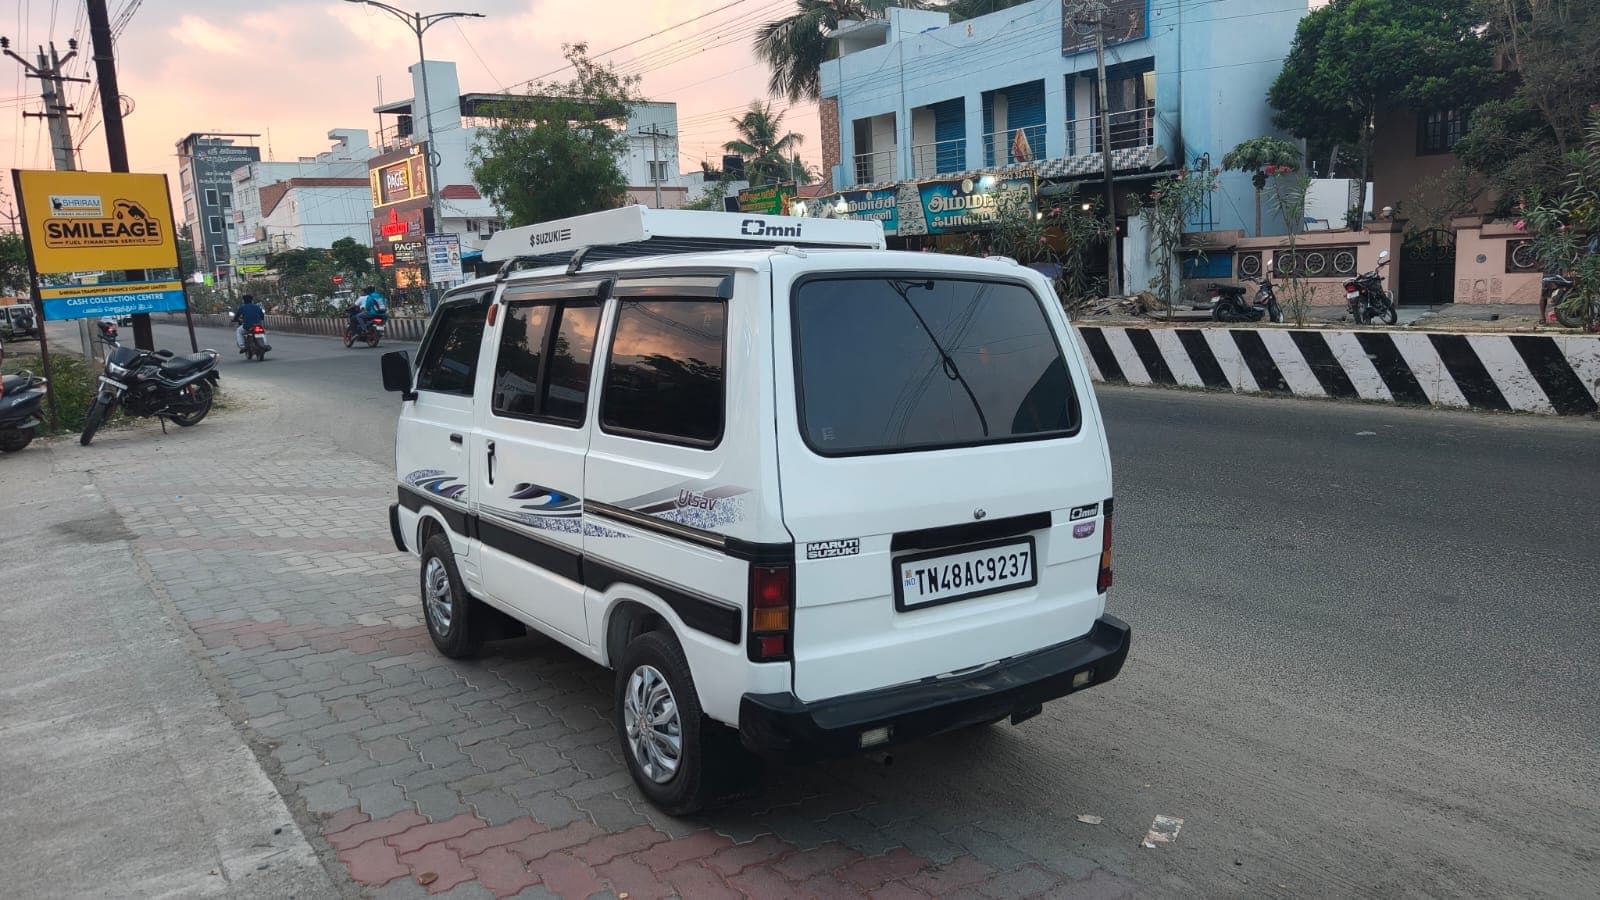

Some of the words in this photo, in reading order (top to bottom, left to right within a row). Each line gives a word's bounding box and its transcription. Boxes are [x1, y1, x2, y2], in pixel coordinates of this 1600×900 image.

[62, 199, 100, 207] SHRIRAM
[47, 222, 159, 239] SMILEAGE
[741, 219, 801, 237] Omni
[536, 231, 561, 245] SUZUKI
[90, 296, 136, 305] COLLECTION
[137, 293, 164, 301] CENTRE
[678, 489, 718, 511] Utsav
[1071, 505, 1097, 519] Omni
[808, 540, 859, 551] MARUTI
[808, 547, 859, 559] SUZUKI
[916, 552, 1029, 595] TN48AC9237
[904, 578, 916, 587] IND
